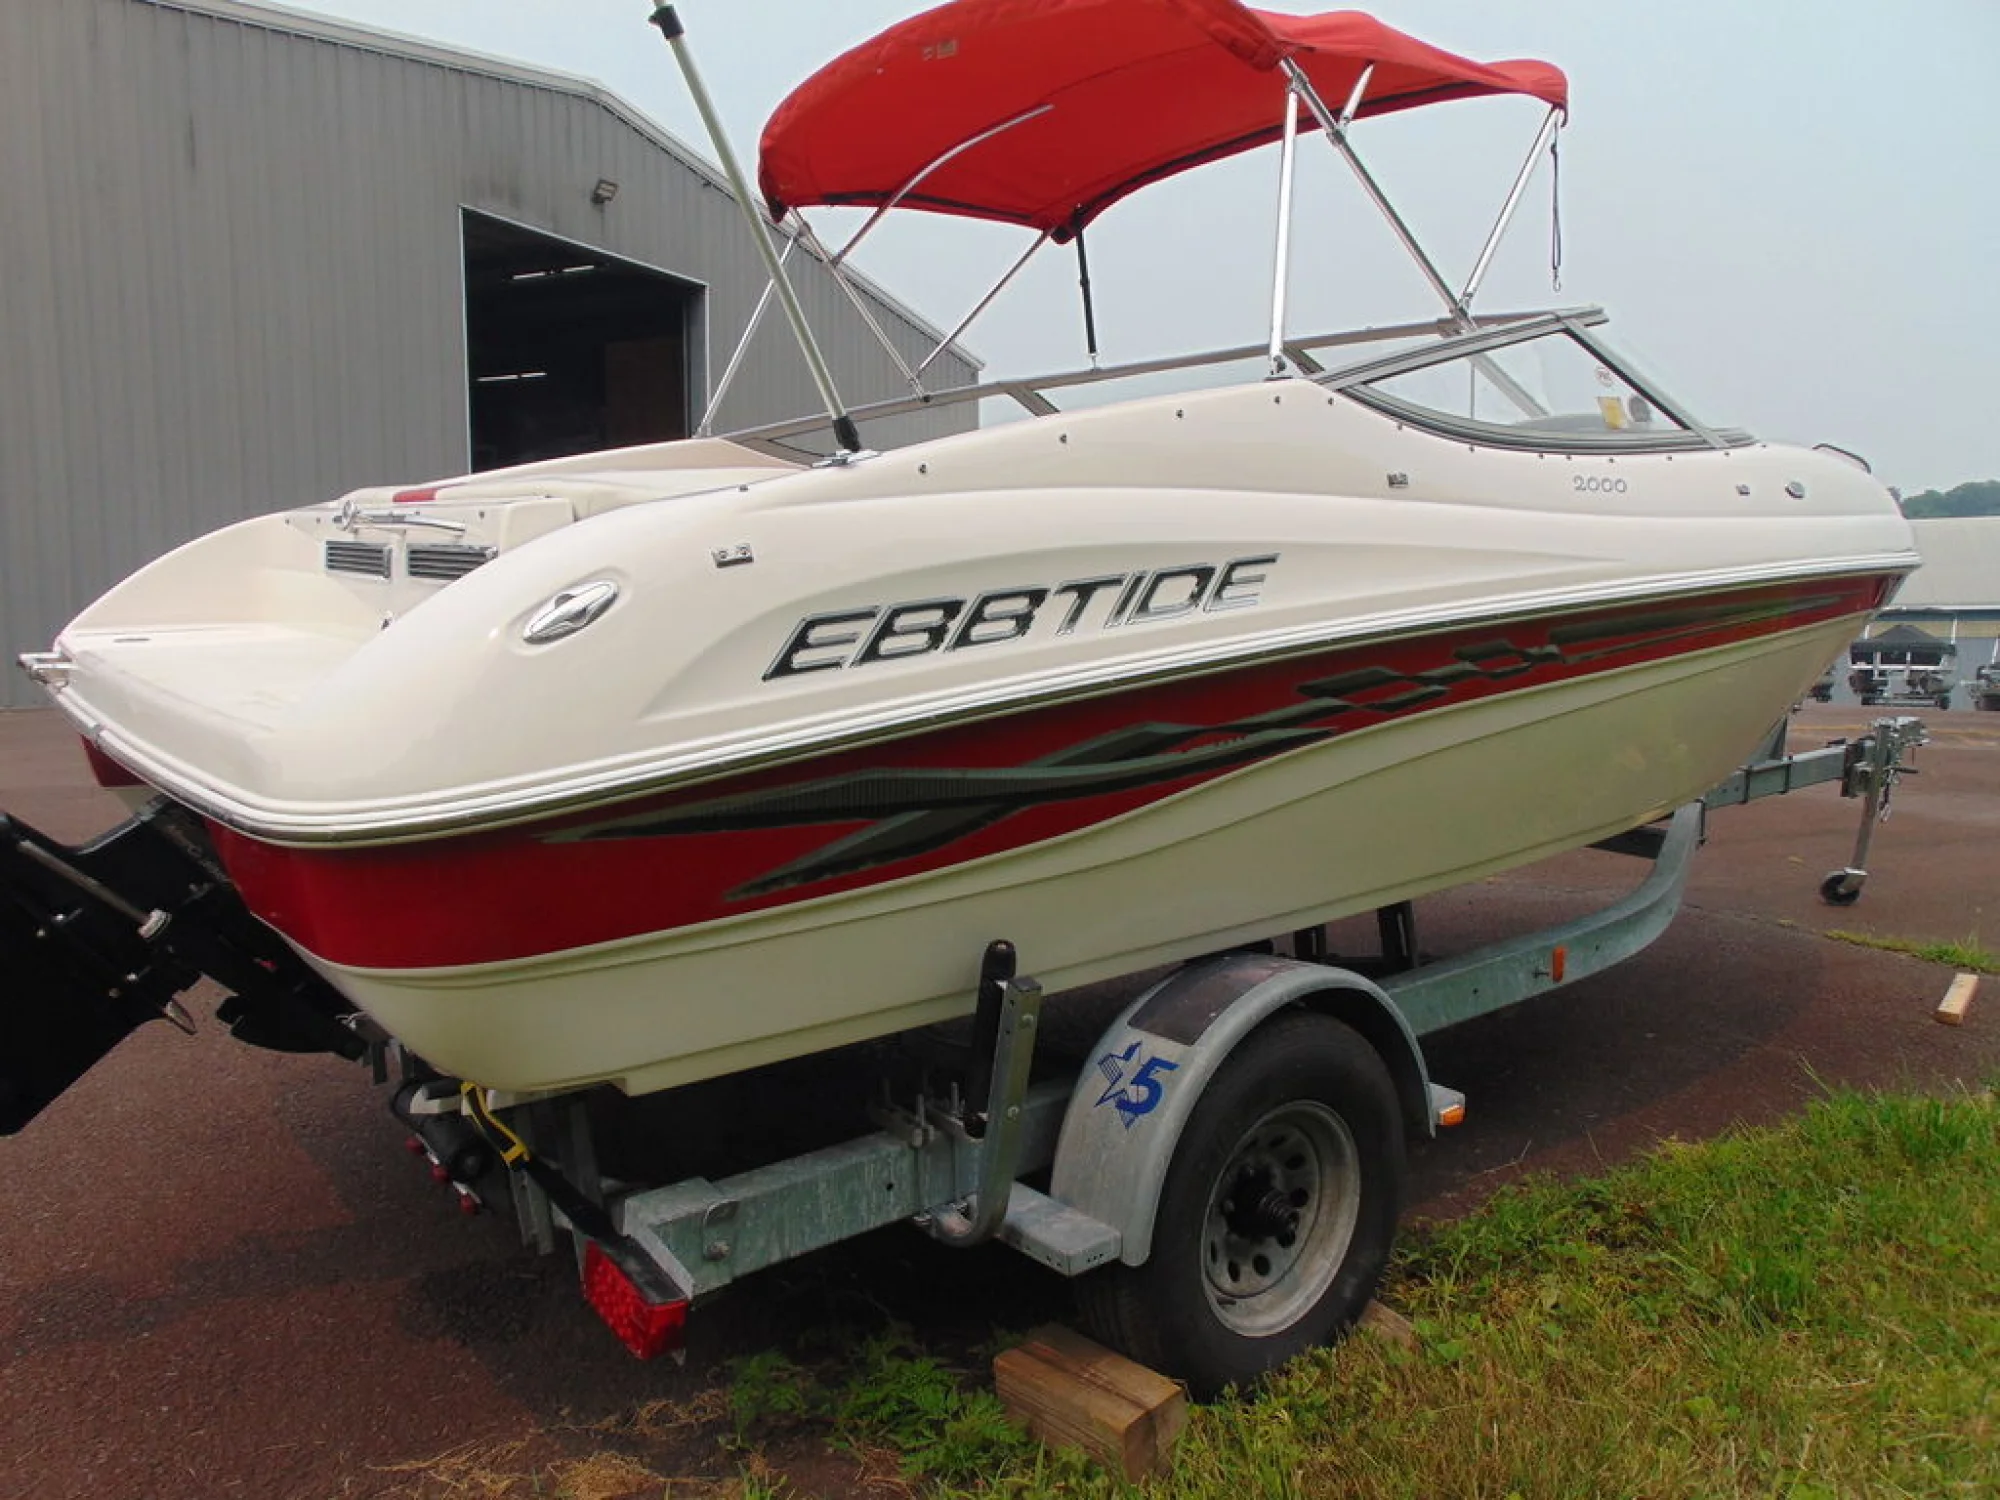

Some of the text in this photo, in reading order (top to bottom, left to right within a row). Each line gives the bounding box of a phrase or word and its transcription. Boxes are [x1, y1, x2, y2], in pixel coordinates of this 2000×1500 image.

[1573, 474, 1628, 493] 2000
[761, 552, 1281, 682] EBBTIDE
[1115, 1055, 1180, 1115] 5
